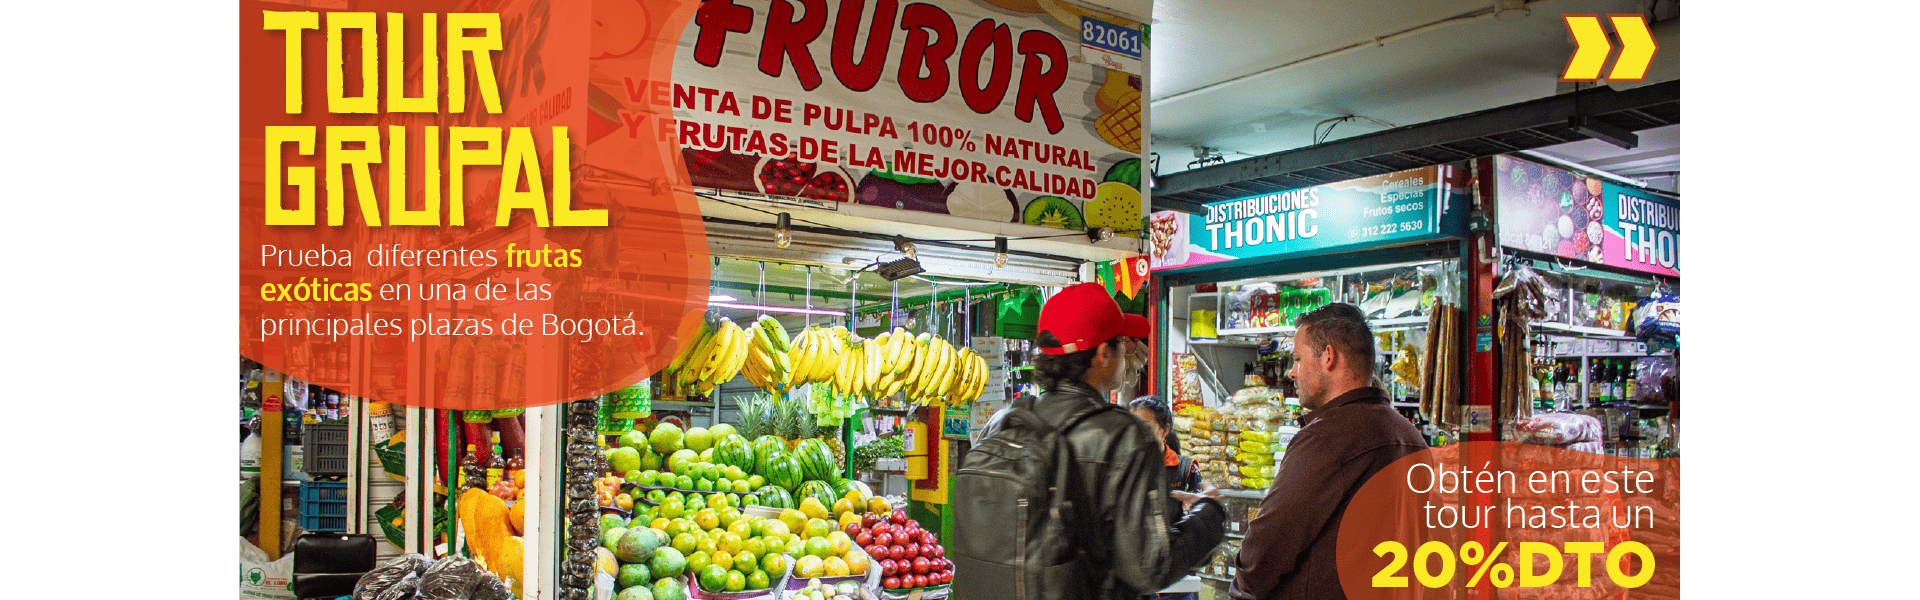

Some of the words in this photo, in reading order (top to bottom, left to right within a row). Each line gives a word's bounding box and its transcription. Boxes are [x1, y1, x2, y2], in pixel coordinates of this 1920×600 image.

[1083, 20, 1140, 53] 82061
[693, 0, 1069, 135] FRUBOR
[623, 76, 740, 117] VENTA
[752, 95, 792, 124] DE
[803, 102, 898, 140] PULPA
[907, 120, 976, 152] 100%
[985, 133, 1096, 172] NATURAL
[622, 113, 646, 139] Y
[658, 116, 788, 157] FRUTAS
[800, 136, 838, 164] DE
[849, 143, 886, 170] LA
[894, 149, 988, 184] MEJOR
[995, 165, 1097, 200] CALIDAD
[1380, 188, 1424, 204] Especias
[1382, 176, 1424, 191] Cereales
[1205, 187, 1320, 225] DISTRIBUICIONES
[1362, 206, 1393, 218] Frutos
[1395, 201, 1424, 214] secos
[1618, 193, 1680, 232] DISTRIBUI
[1205, 208, 1319, 252] THONIC
[1361, 227, 1379, 238] 312
[1380, 223, 1398, 235] 222
[1399, 219, 1423, 232] 5630
[1618, 221, 1680, 269] THO
